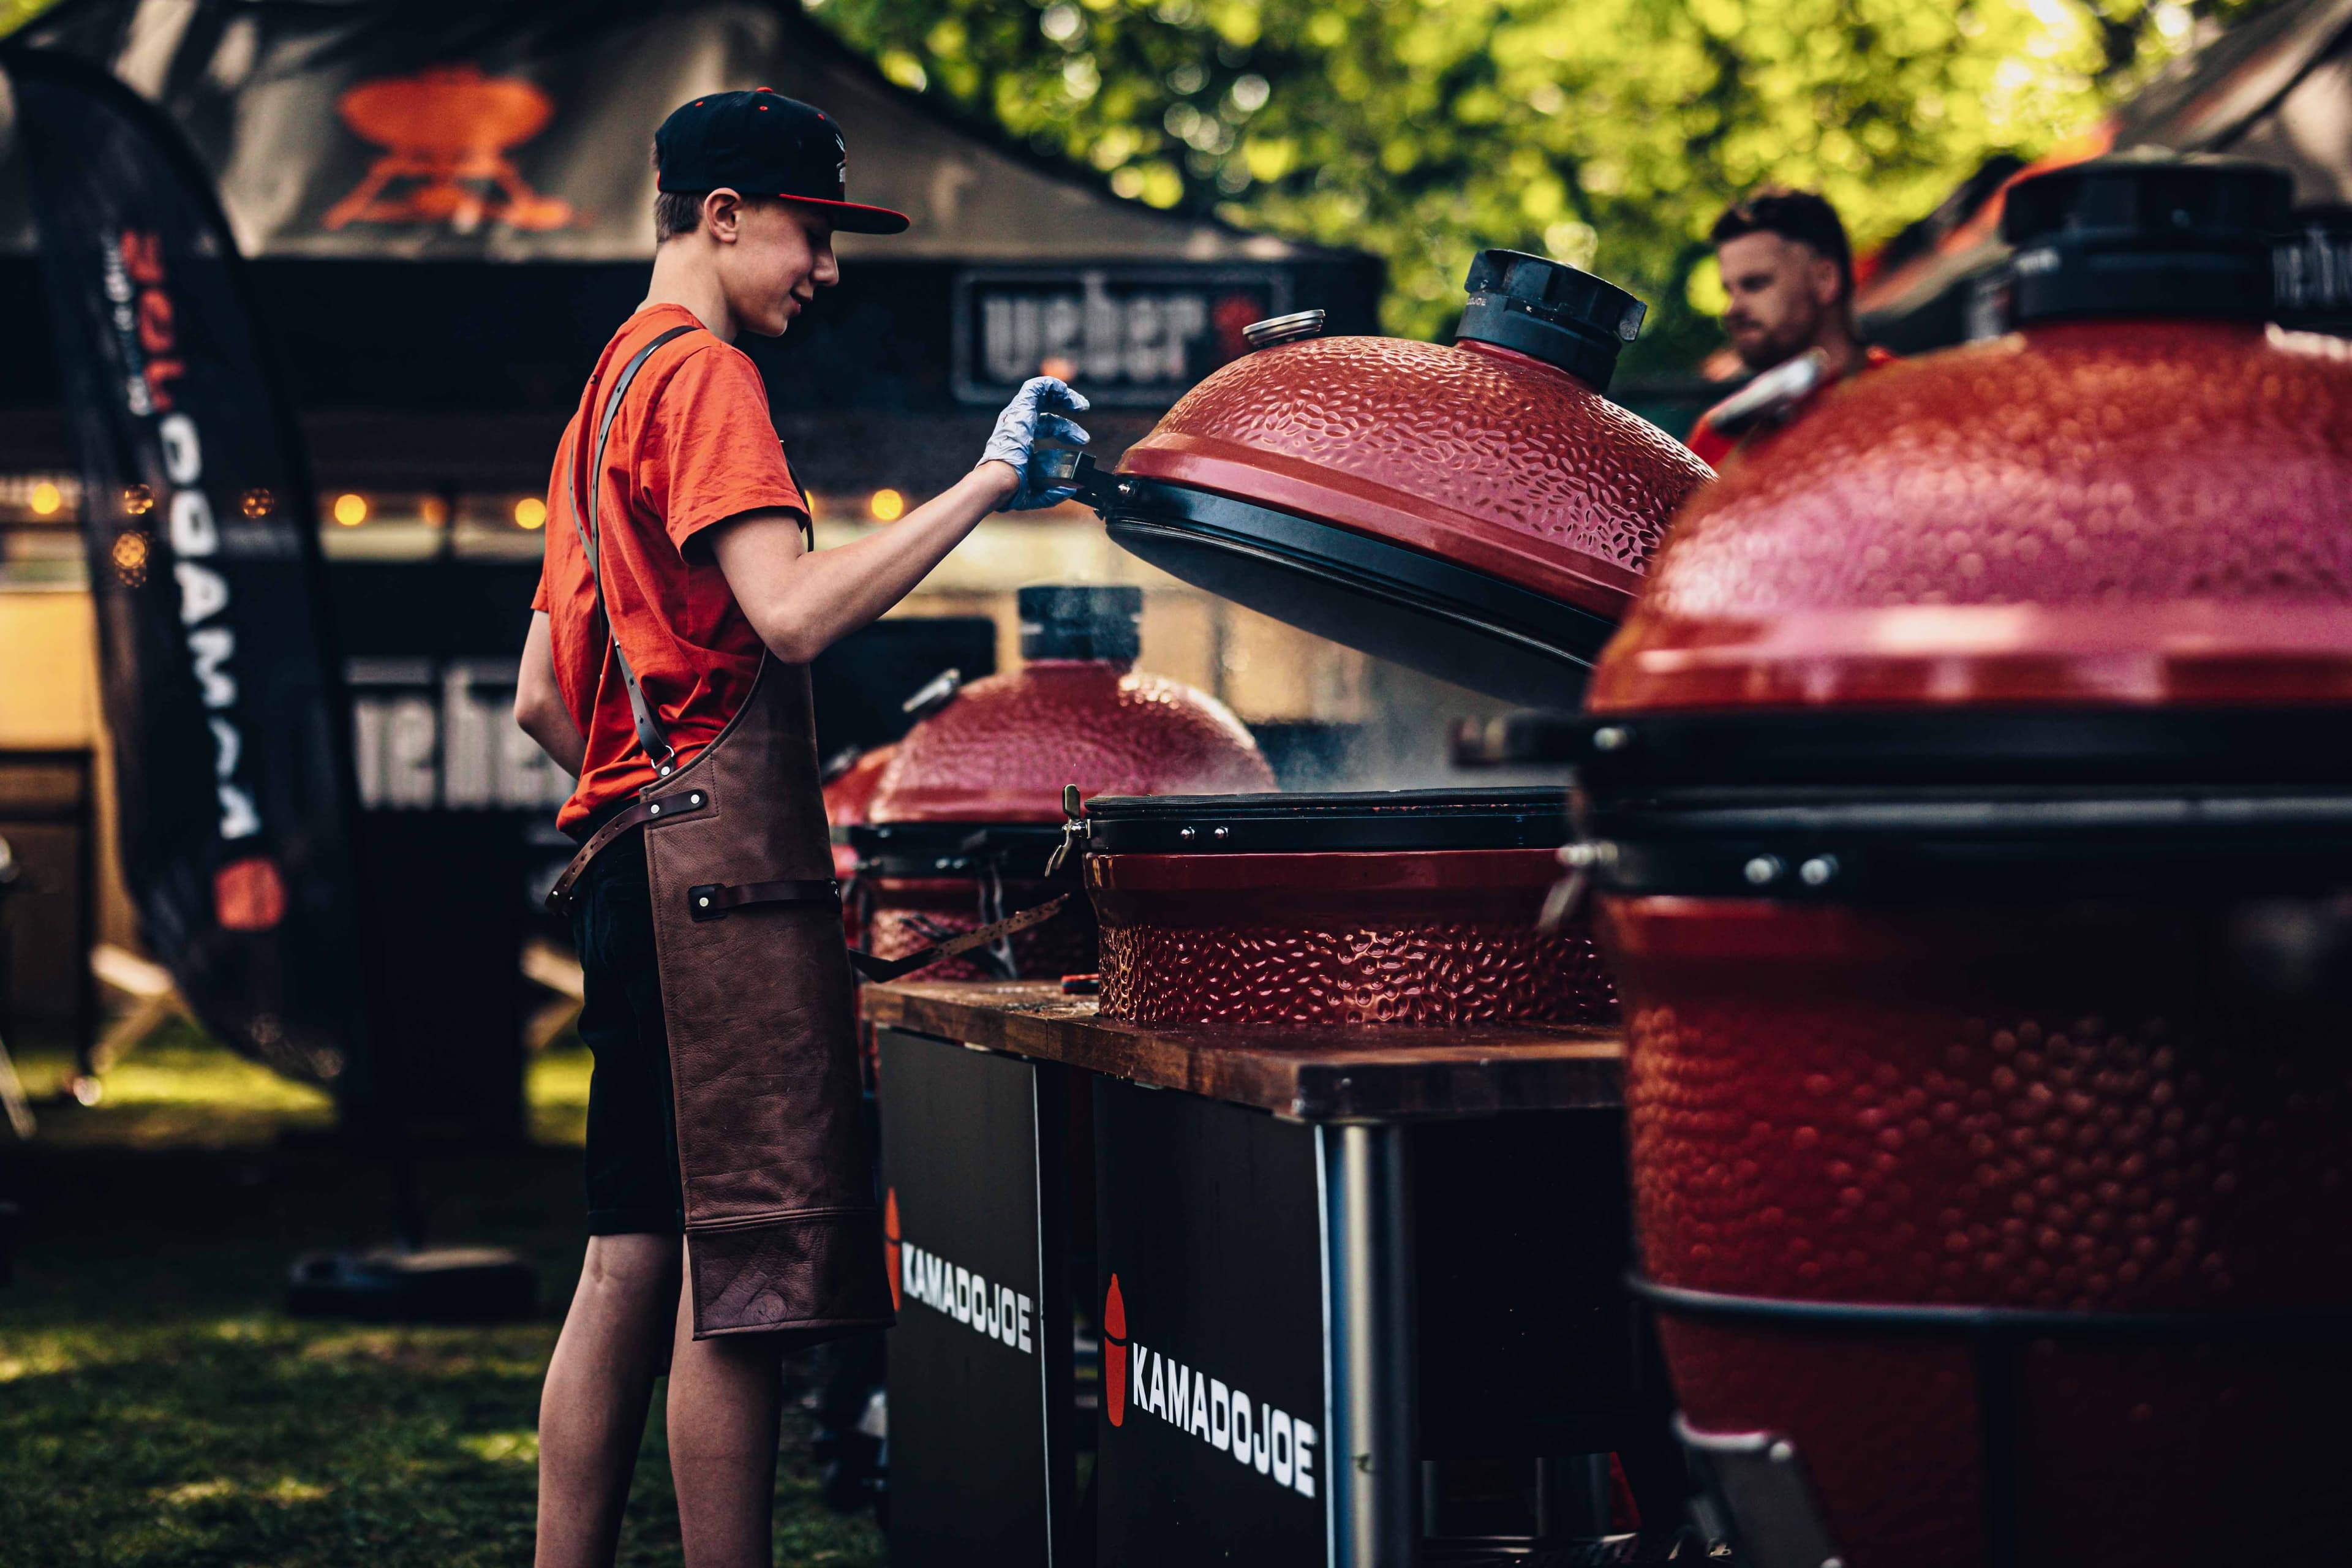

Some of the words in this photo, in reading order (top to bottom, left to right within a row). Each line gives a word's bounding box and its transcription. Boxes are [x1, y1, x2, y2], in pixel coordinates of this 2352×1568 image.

[355, 666, 577, 806] ebe
[902, 1242, 1032, 1354] KAMADOJOE
[1133, 1342, 1316, 1498] KAMADOJOE
